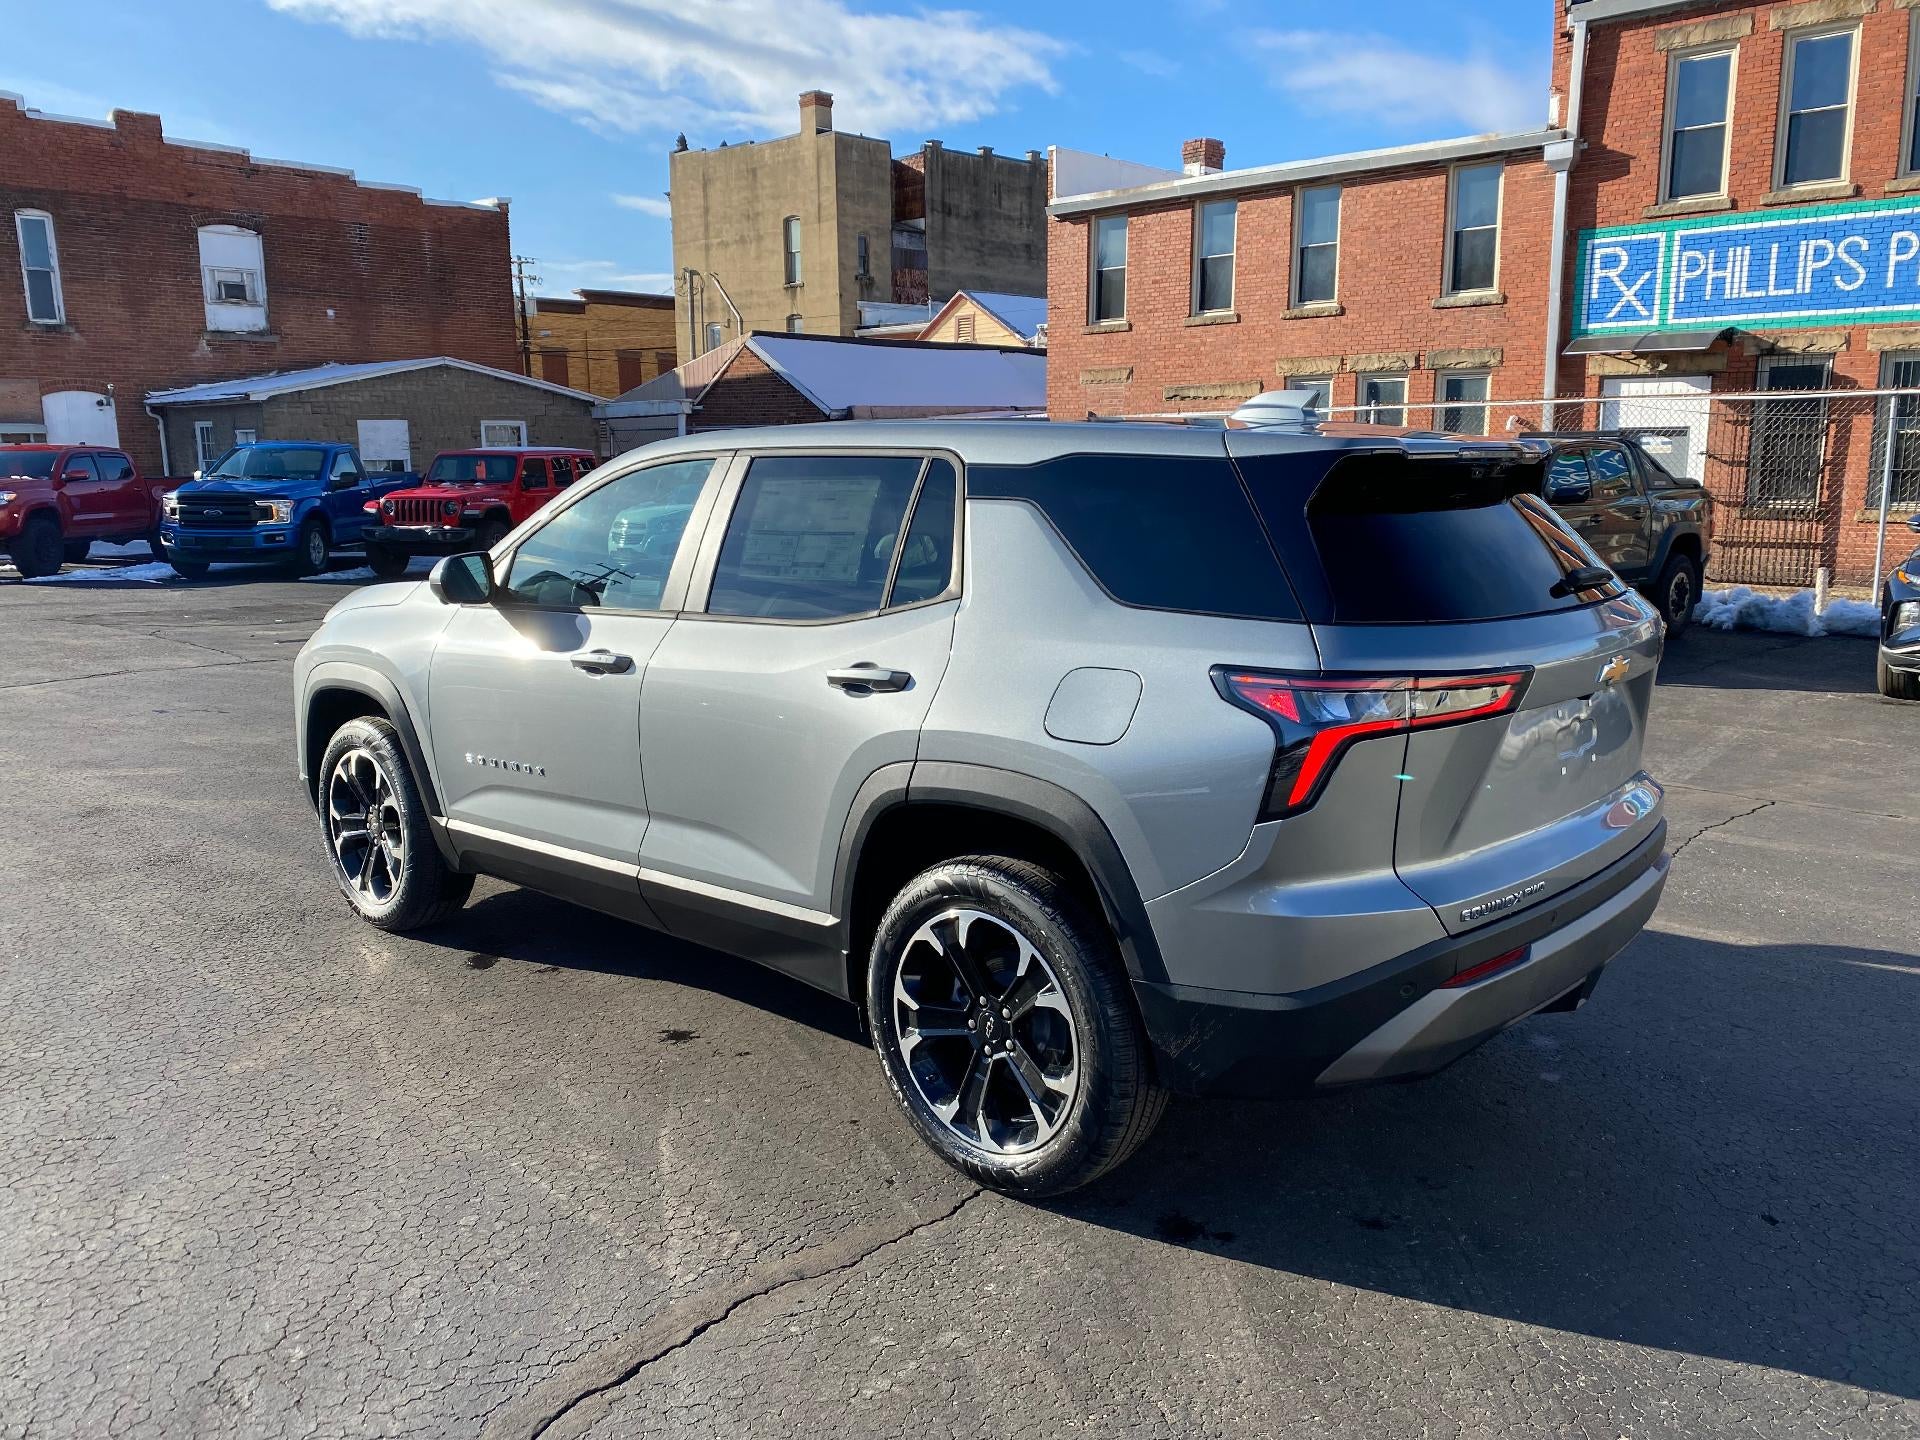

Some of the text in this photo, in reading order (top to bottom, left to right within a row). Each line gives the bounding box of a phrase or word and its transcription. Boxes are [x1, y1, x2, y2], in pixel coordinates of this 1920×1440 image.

[1678, 230, 1920, 302] PHILLIPS P
[1461, 890, 1522, 921] EQUINOX
